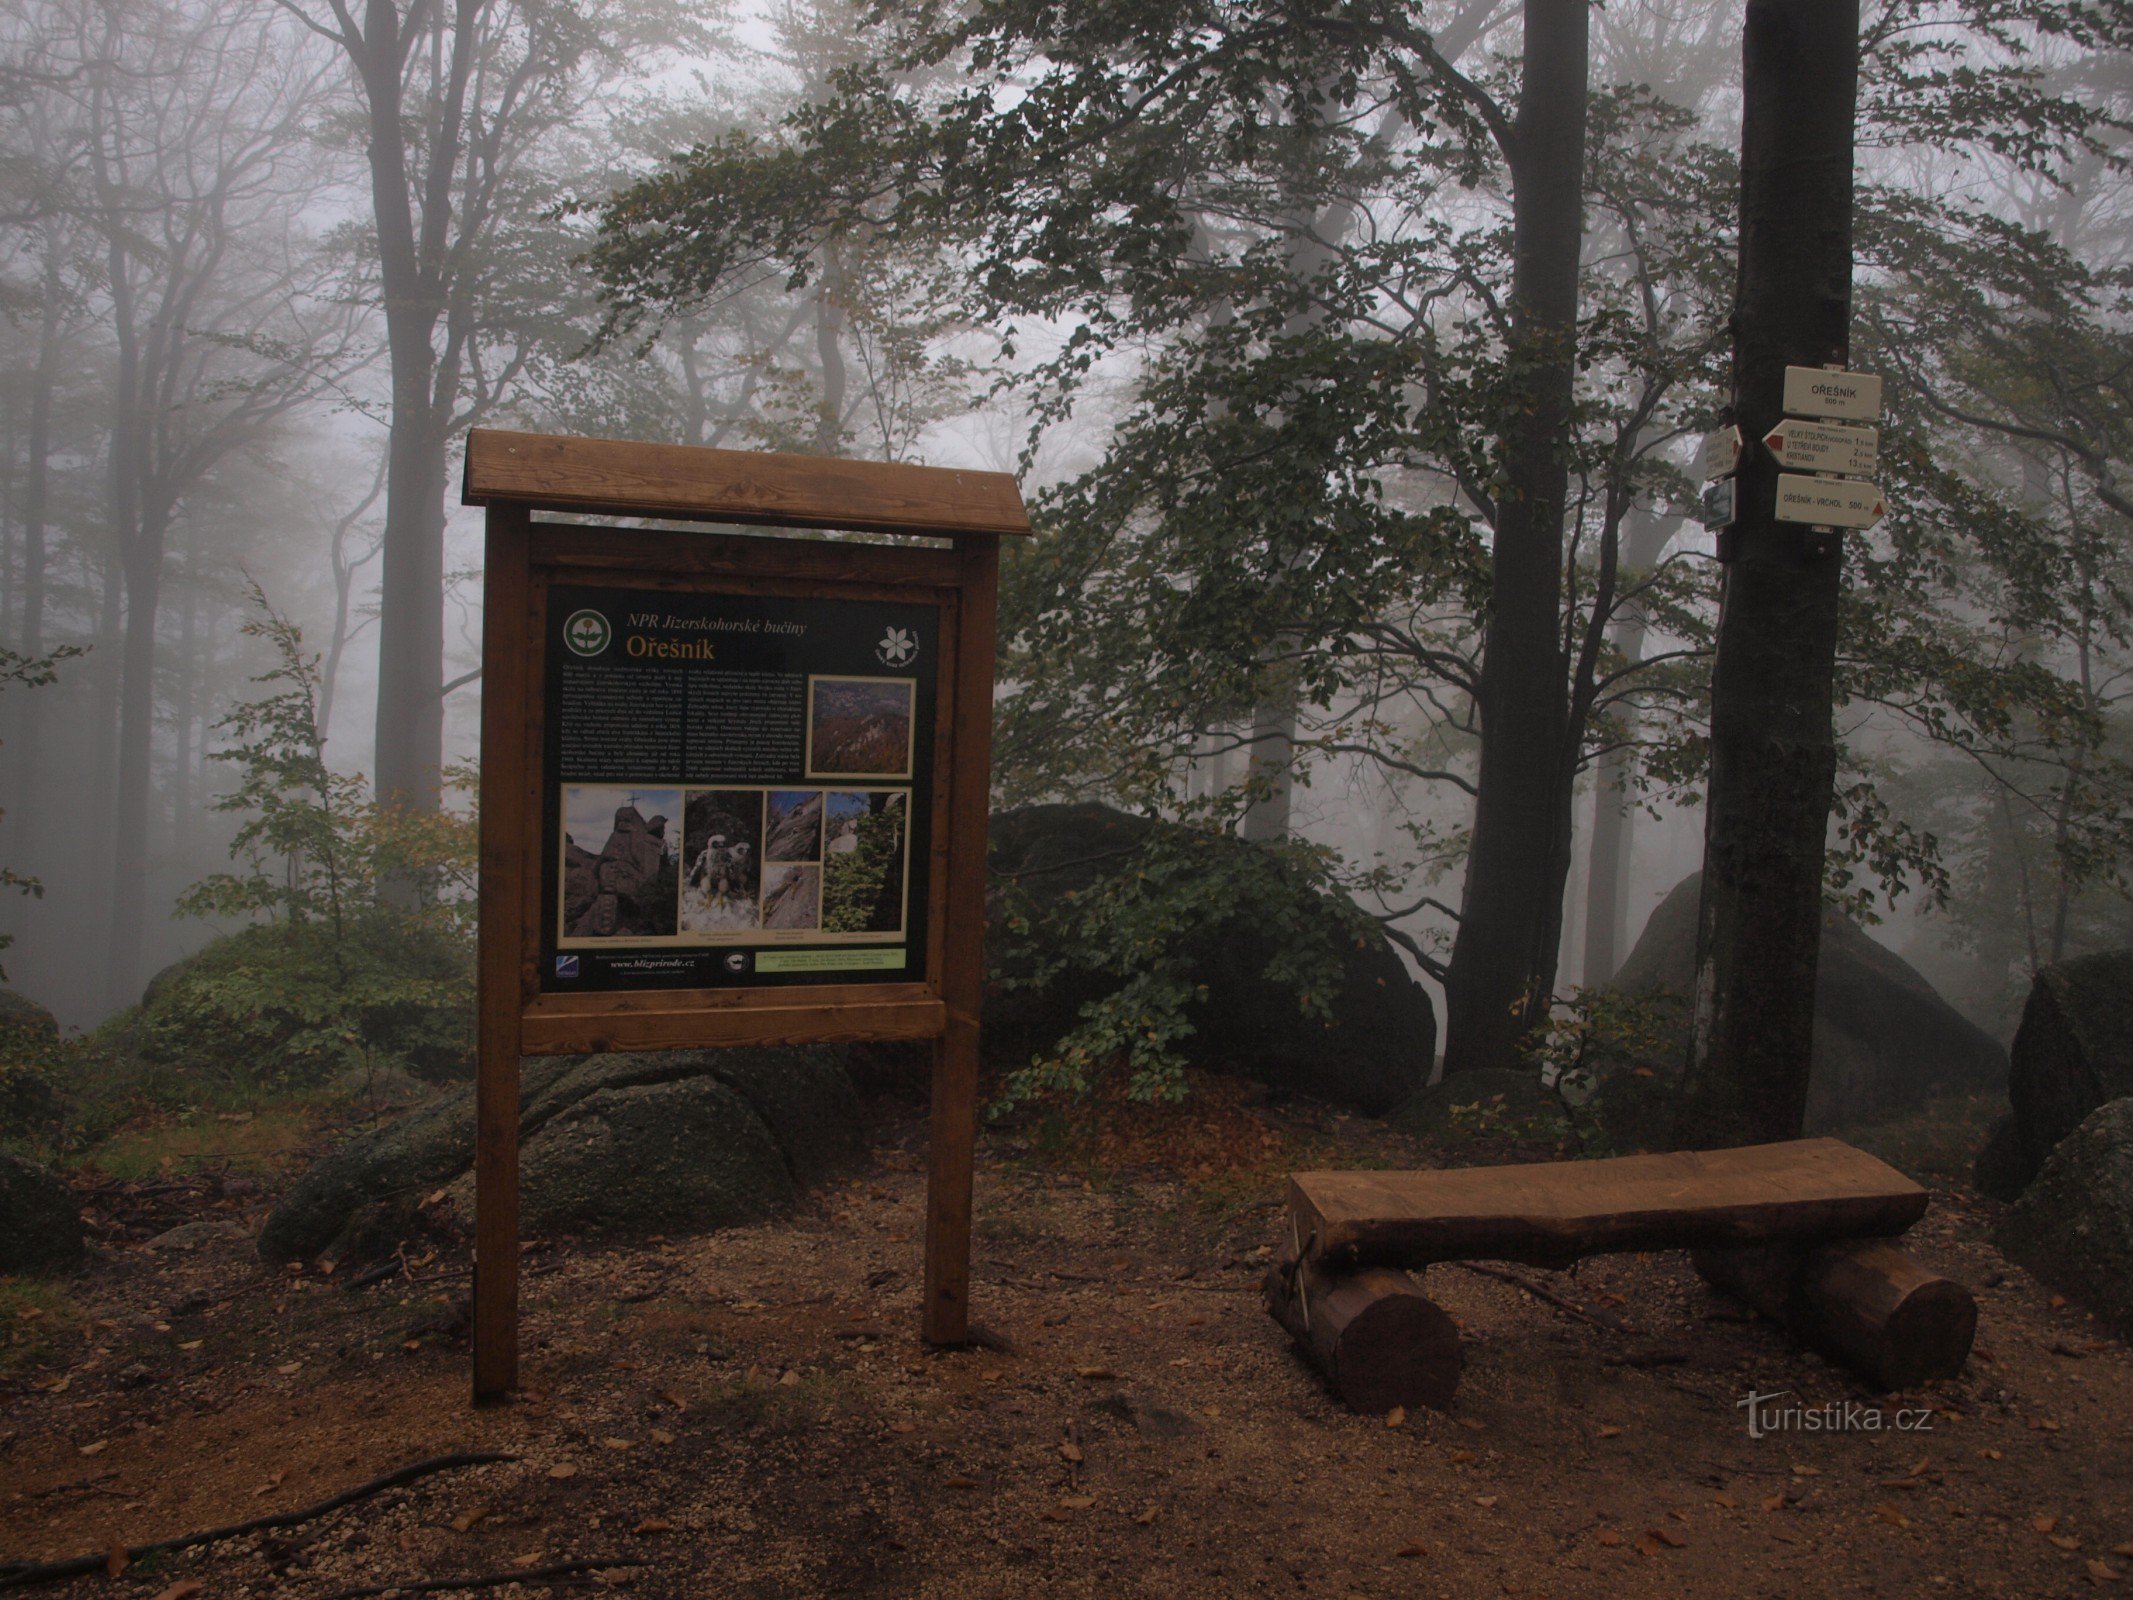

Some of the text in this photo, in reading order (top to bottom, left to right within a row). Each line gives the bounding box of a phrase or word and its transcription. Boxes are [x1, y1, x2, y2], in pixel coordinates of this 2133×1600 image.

[1811, 384, 1856, 399] OŘEŠNÍK
[1784, 493, 1812, 505] OŘEŠNÍK
[1816, 498, 1842, 508] VRCHOL
[1849, 501, 1862, 510] 500
[626, 613, 807, 636] NPR Jizerskohorské bučiny
[626, 634, 715, 660] Ořešník
[610, 959, 695, 969] www.blizprirode.cz
